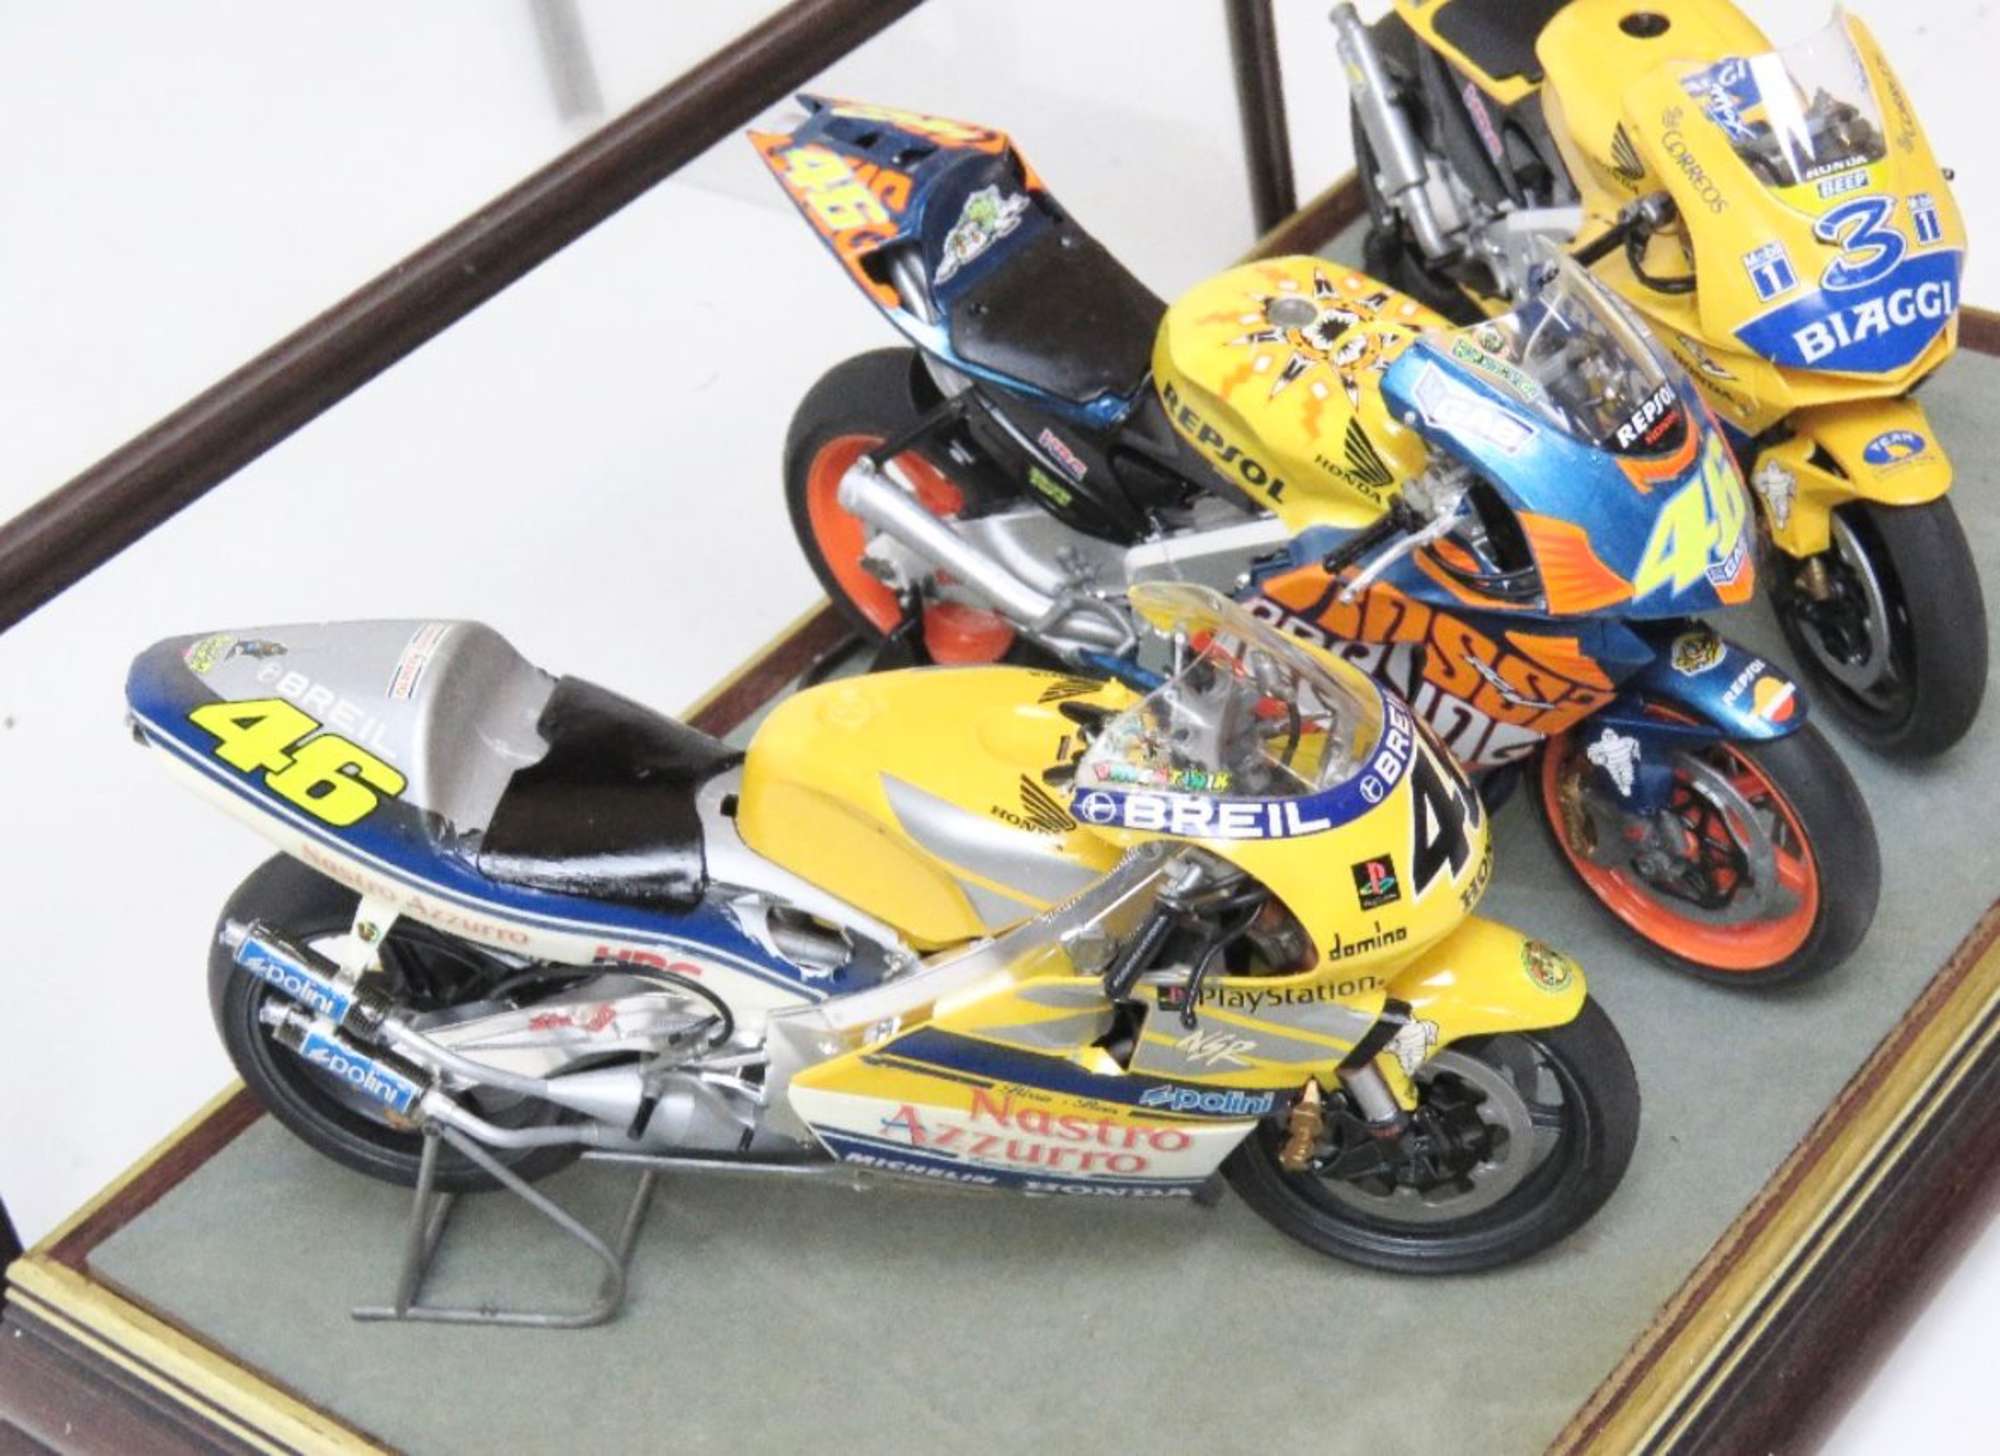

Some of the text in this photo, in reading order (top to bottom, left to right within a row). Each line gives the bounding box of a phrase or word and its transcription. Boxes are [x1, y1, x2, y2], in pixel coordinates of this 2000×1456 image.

[783, 147, 891, 230] 46
[1662, 129, 1729, 214] CORREOS
[1813, 195, 1907, 291] 3
[1793, 281, 1952, 364] BIAGGI
[1162, 380, 1287, 505] REPSOL
[1616, 382, 1677, 449] REPSOL
[1314, 453, 1382, 504] HONDA
[1632, 427, 1747, 604] 46
[275, 670, 397, 758] BREIL
[1721, 658, 1766, 708] REPSOL
[188, 697, 408, 827] 46
[990, 804, 1062, 842] HON
[1123, 793, 1332, 839] BREIL
[1328, 921, 1408, 962] domino
[265, 960, 335, 1015] polini
[1198, 976, 1378, 1014] PlayStation
[329, 1054, 398, 1105] polini
[1170, 1089, 1277, 1115] polini
[880, 1103, 1148, 1175] Azzurro
[969, 1085, 1192, 1153] Nastro
[845, 1152, 998, 1185] MICHELIN
